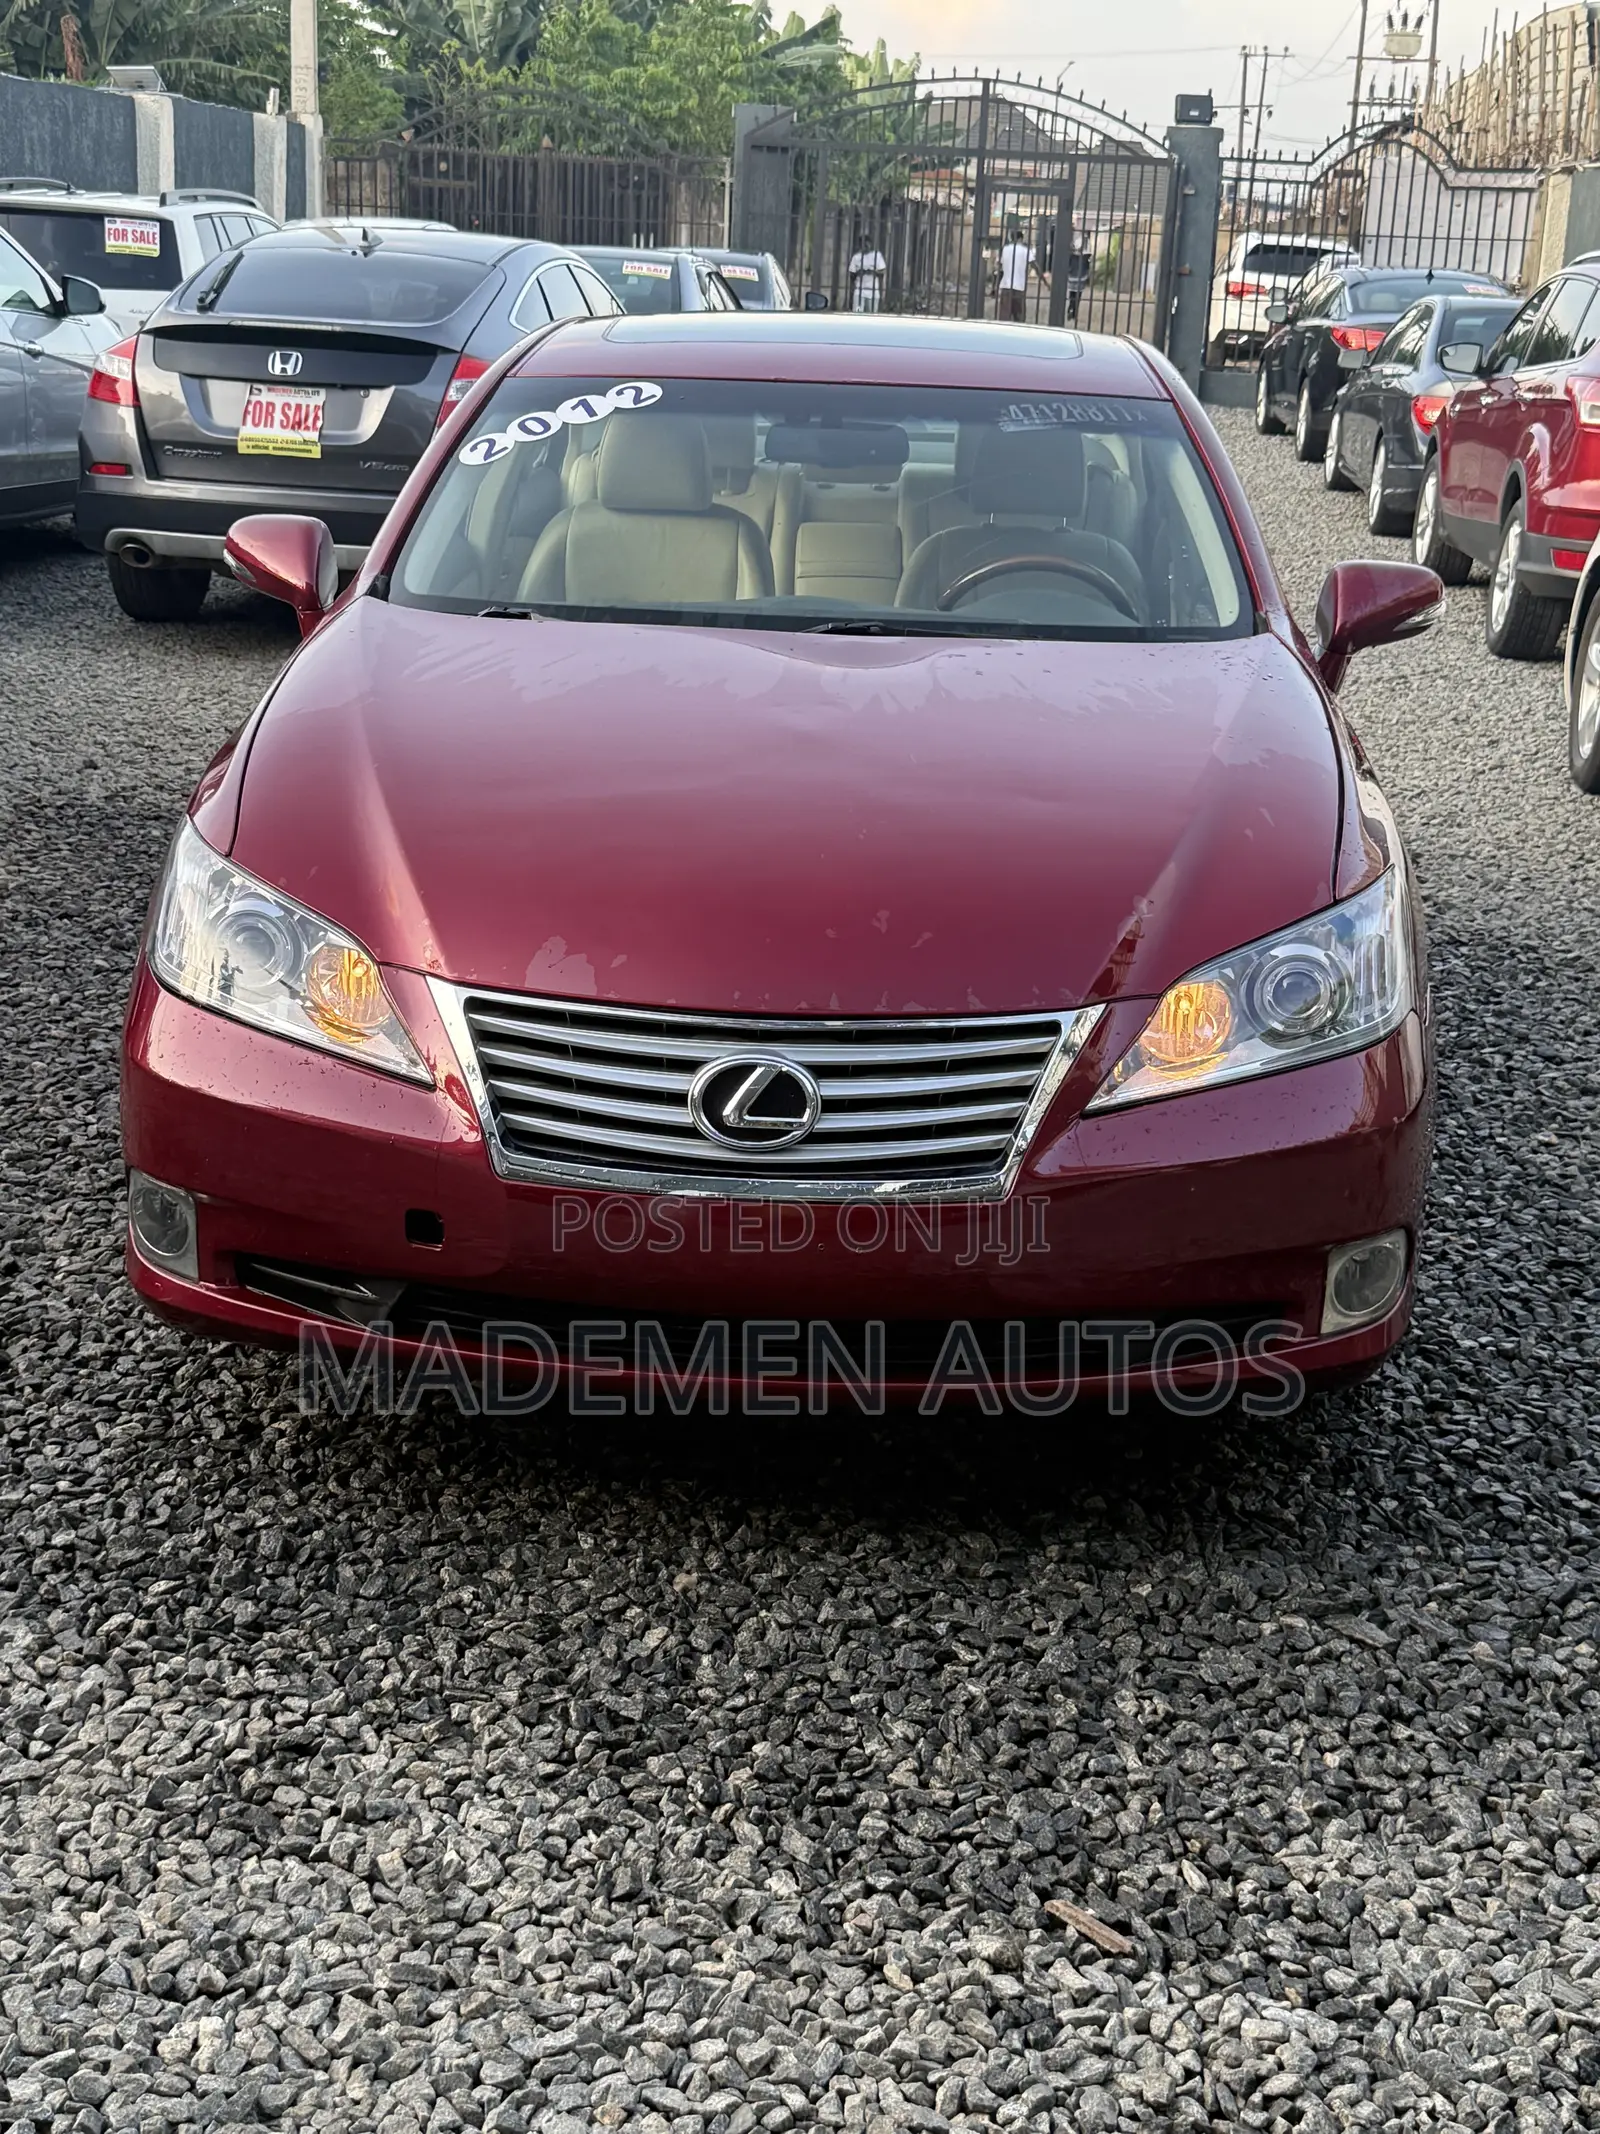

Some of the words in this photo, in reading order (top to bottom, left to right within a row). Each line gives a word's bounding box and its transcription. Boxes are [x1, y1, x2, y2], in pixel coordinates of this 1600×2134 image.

[107, 228, 128, 242] FOR
[131, 229, 158, 246] SALE
[624, 264, 644, 272] FOR
[646, 266, 669, 275] SALE
[242, 399, 277, 429] FOR
[279, 402, 321, 432] SALE
[469, 384, 658, 462] 2012
